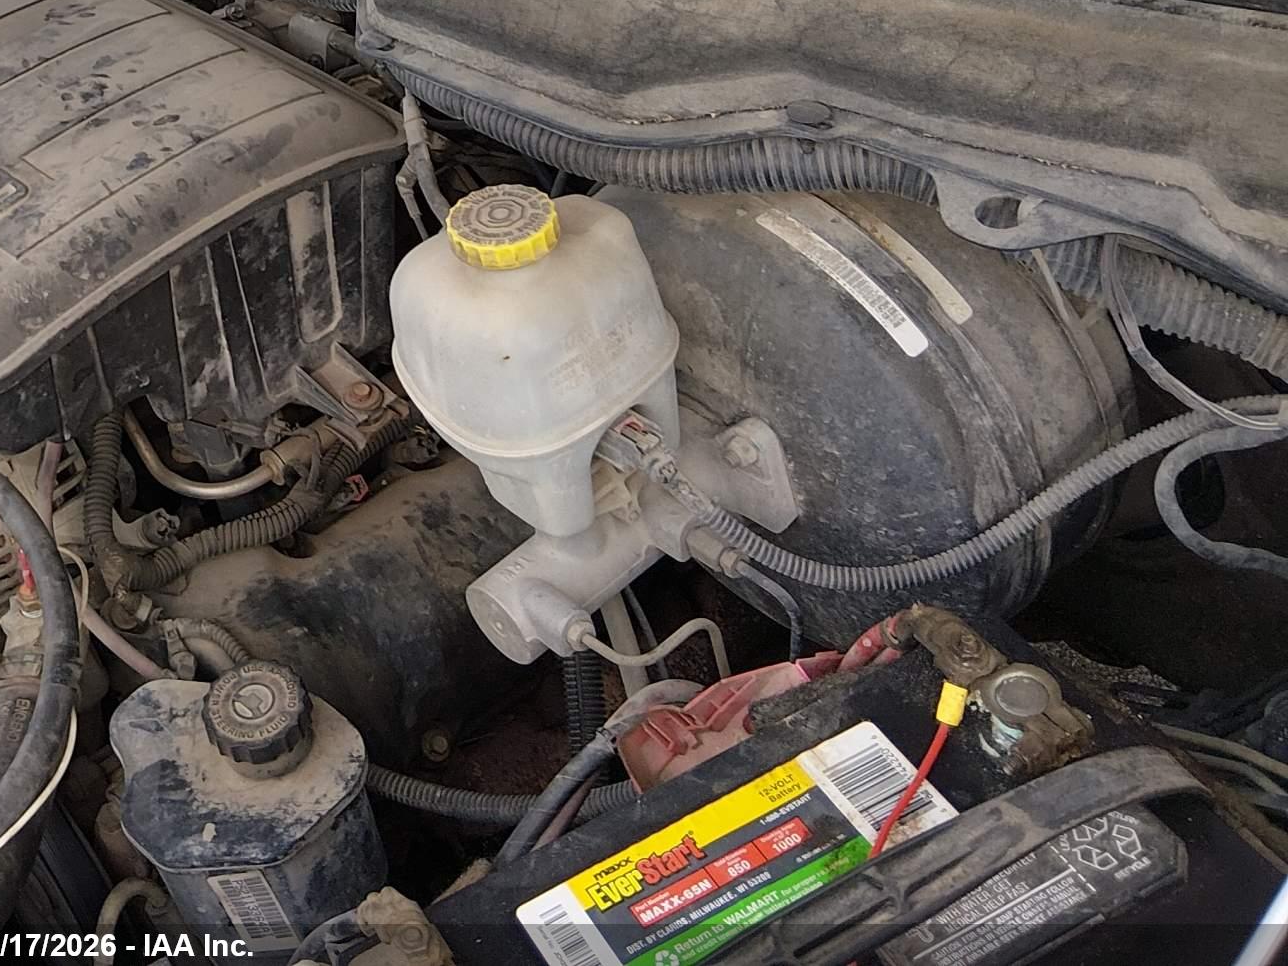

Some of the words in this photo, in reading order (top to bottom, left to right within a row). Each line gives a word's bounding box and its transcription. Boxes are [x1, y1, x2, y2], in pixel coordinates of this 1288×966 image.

[757, 772, 796, 800] 12-VOLT
[768, 780, 802, 805] Battery
[771, 831, 802, 854] 1000
[586, 835, 706, 913] EverStart
[593, 856, 632, 882] maxx
[727, 859, 751, 878] 850
[625, 937, 647, 955] DIST.
[645, 932, 658, 944] BY
[735, 882, 749, 894] WI
[639, 878, 711, 924] MAXX-65N
[674, 927, 712, 954] Return
[711, 921, 725, 934] to
[722, 890, 780, 928] WALMART
[935, 906, 961, 925] WITH
[992, 877, 1012, 894] GET
[943, 906, 984, 933] MEDICAL
[981, 893, 1006, 912] HELP
[1003, 880, 1030, 900] FAST
